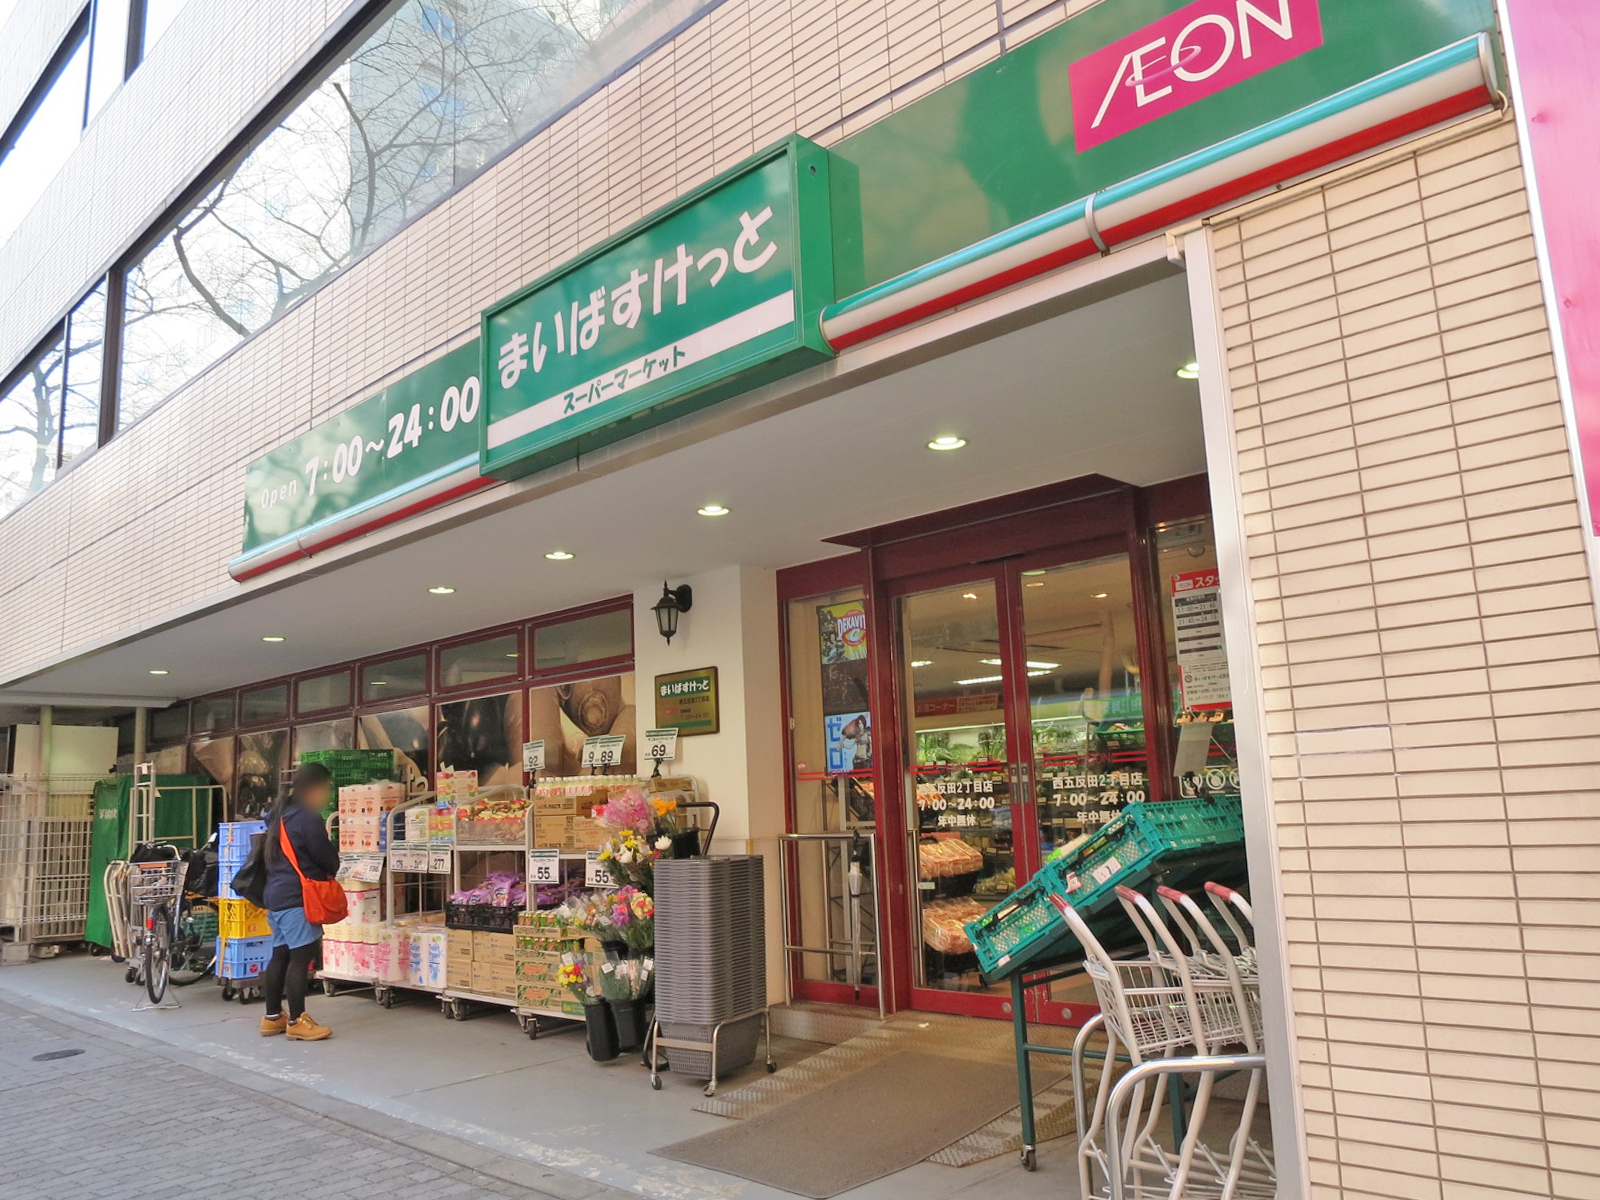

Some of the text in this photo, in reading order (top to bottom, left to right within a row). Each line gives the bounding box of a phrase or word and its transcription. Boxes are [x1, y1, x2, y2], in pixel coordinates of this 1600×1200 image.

[498, 206, 778, 389] まいばすけっと
[563, 345, 686, 414] スーパーマーケット
[261, 479, 297, 508] Open
[660, 679, 710, 697] まいばすけっと
[651, 744, 666, 757] 69
[827, 716, 844, 769] ゼロ
[528, 755, 539, 768] 92
[600, 750, 614, 763] 89
[1052, 772, 1143, 790] 西五反田2丁目店
[938, 814, 977, 828] 年中無休
[537, 866, 551, 880] 55
[594, 870, 609, 884] 55
